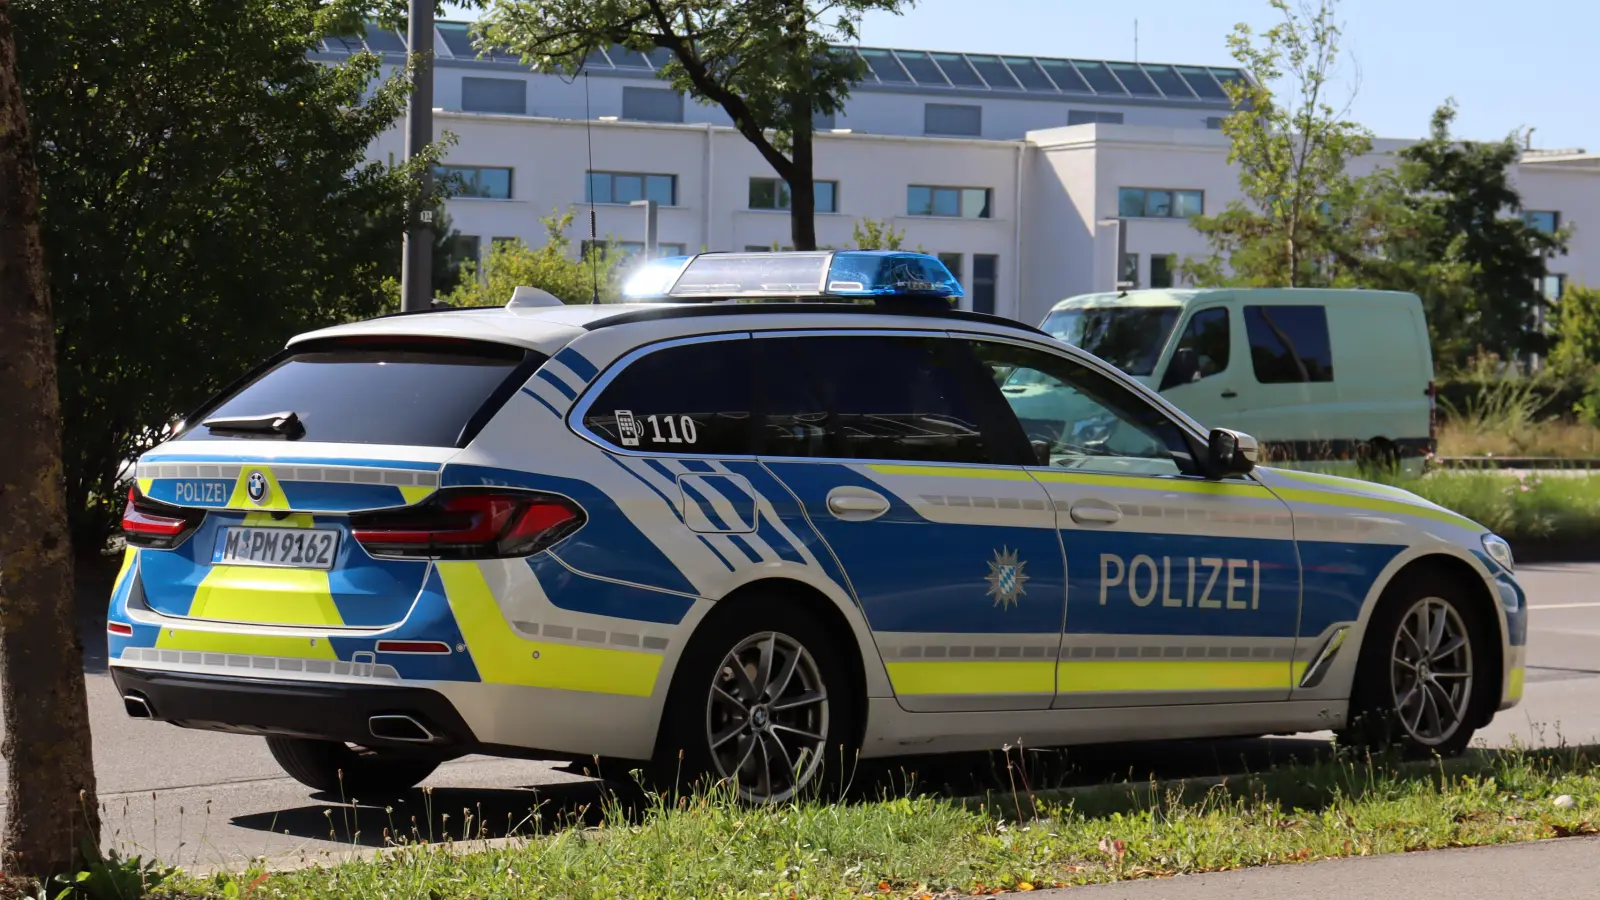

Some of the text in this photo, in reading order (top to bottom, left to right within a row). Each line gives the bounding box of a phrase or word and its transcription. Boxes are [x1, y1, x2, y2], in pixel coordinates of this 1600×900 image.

[647, 415, 697, 444] 110
[175, 482, 227, 502] POLIZEI
[1099, 553, 1260, 610] POLIZEI
